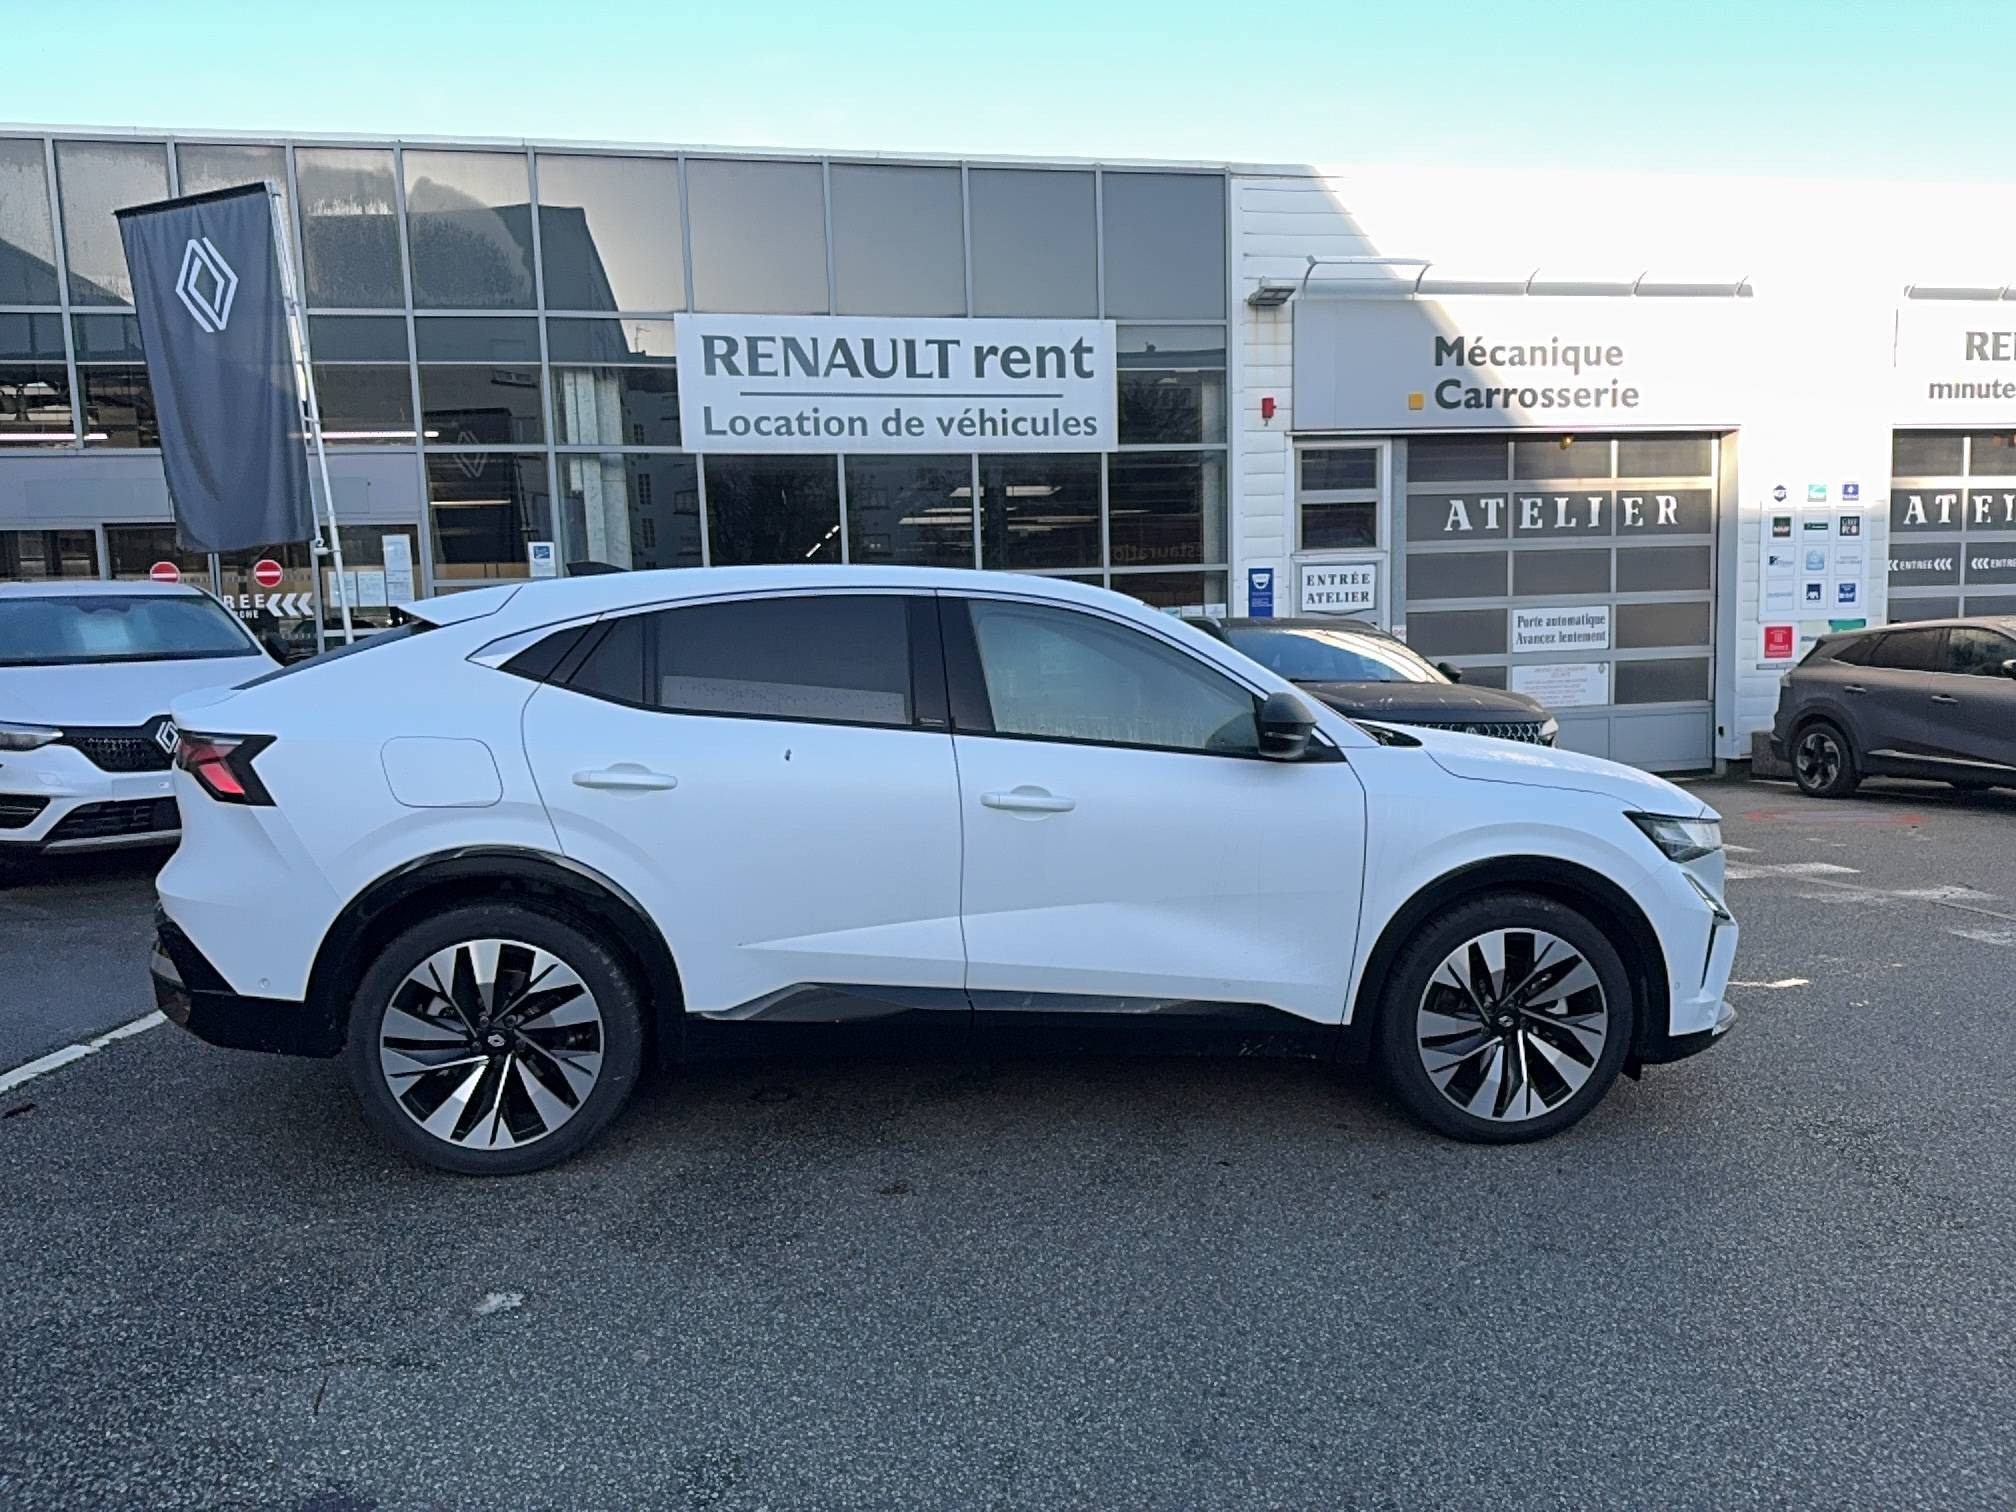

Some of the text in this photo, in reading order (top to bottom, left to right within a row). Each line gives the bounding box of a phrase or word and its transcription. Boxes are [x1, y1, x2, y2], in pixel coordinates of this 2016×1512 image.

[701, 335, 1095, 379] RENAULT rent
[1434, 336, 1624, 375] Mécanique
[1434, 378, 1640, 410] Carrosserie
[704, 406, 1098, 438] Location de véhicules
[1443, 495, 1679, 531] ATELIER
[1306, 571, 1371, 587] ENTRÉE
[1306, 591, 1370, 605] ATELIER
[1517, 613, 1606, 628] Porte automatique
[1516, 630, 1606, 645] Avancez lentement
